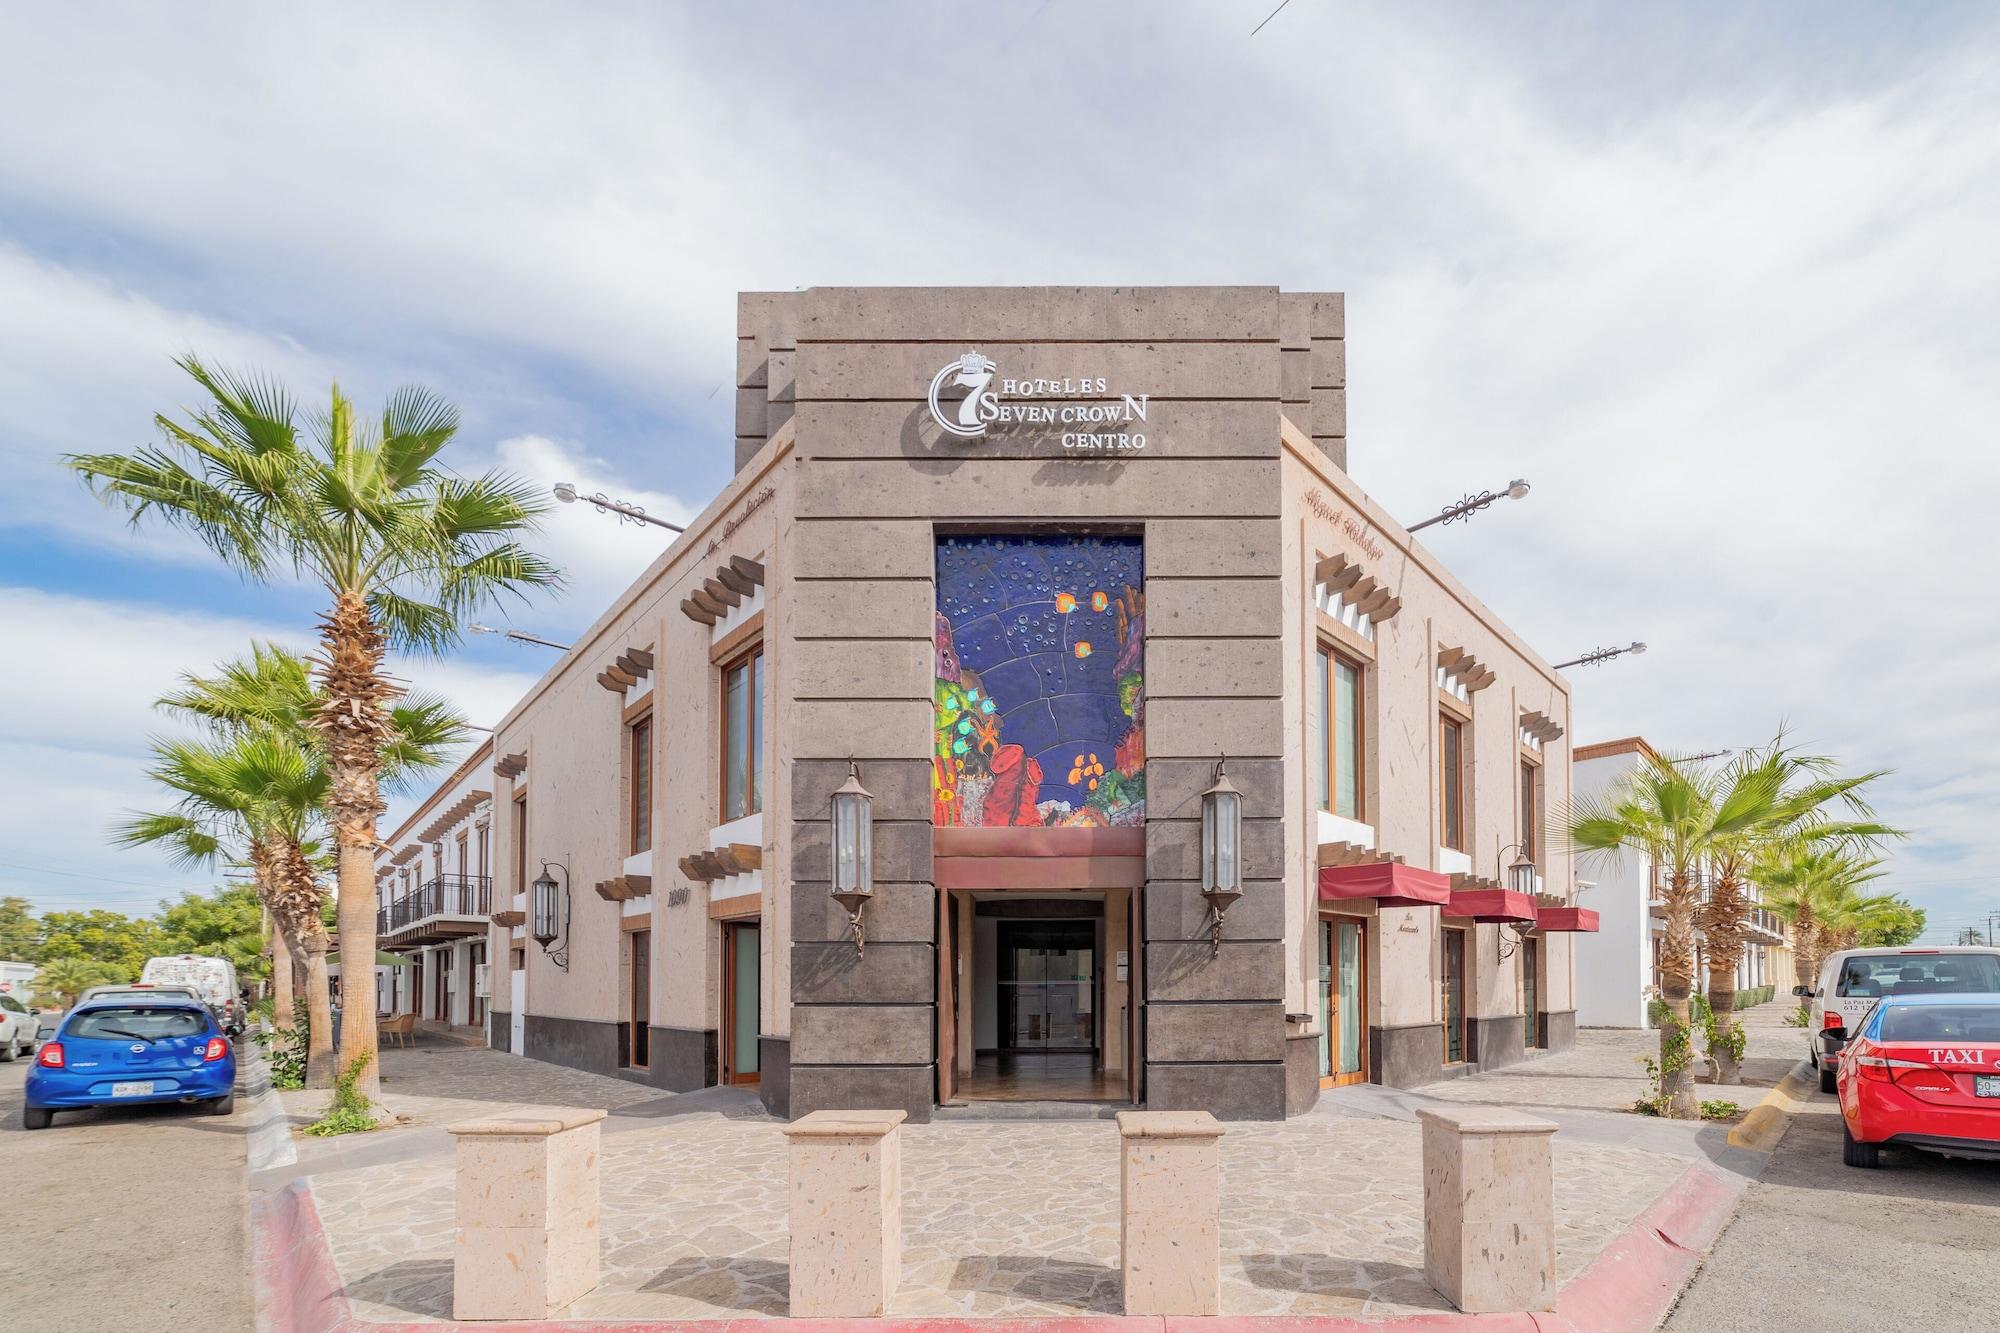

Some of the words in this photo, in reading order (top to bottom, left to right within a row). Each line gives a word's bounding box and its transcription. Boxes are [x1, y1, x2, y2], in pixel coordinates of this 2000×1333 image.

[1002, 378, 1107, 396] HOTELES
[980, 391, 1057, 424] SEVEN
[1061, 393, 1150, 423] CROWN
[1061, 433, 1146, 449] CENTRO
[1928, 1049, 1984, 1065] TAXI
